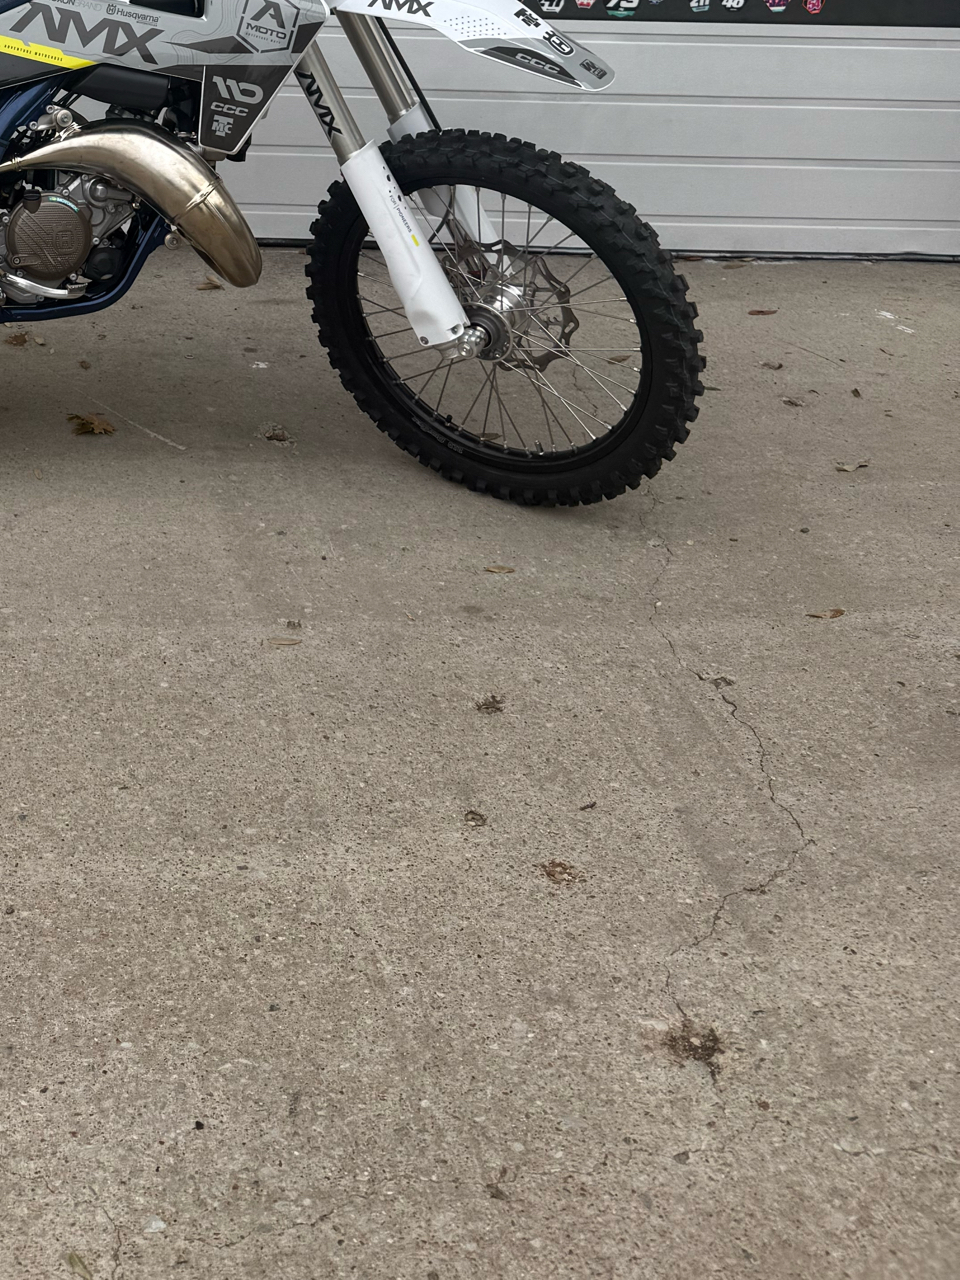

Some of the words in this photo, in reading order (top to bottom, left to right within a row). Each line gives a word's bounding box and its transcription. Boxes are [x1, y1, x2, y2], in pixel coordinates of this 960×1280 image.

[116, 7, 161, 24] Husqvarna
[9, 2, 165, 65] AMX
[246, 22, 287, 40] MOTO
[210, 102, 249, 117] CCC
